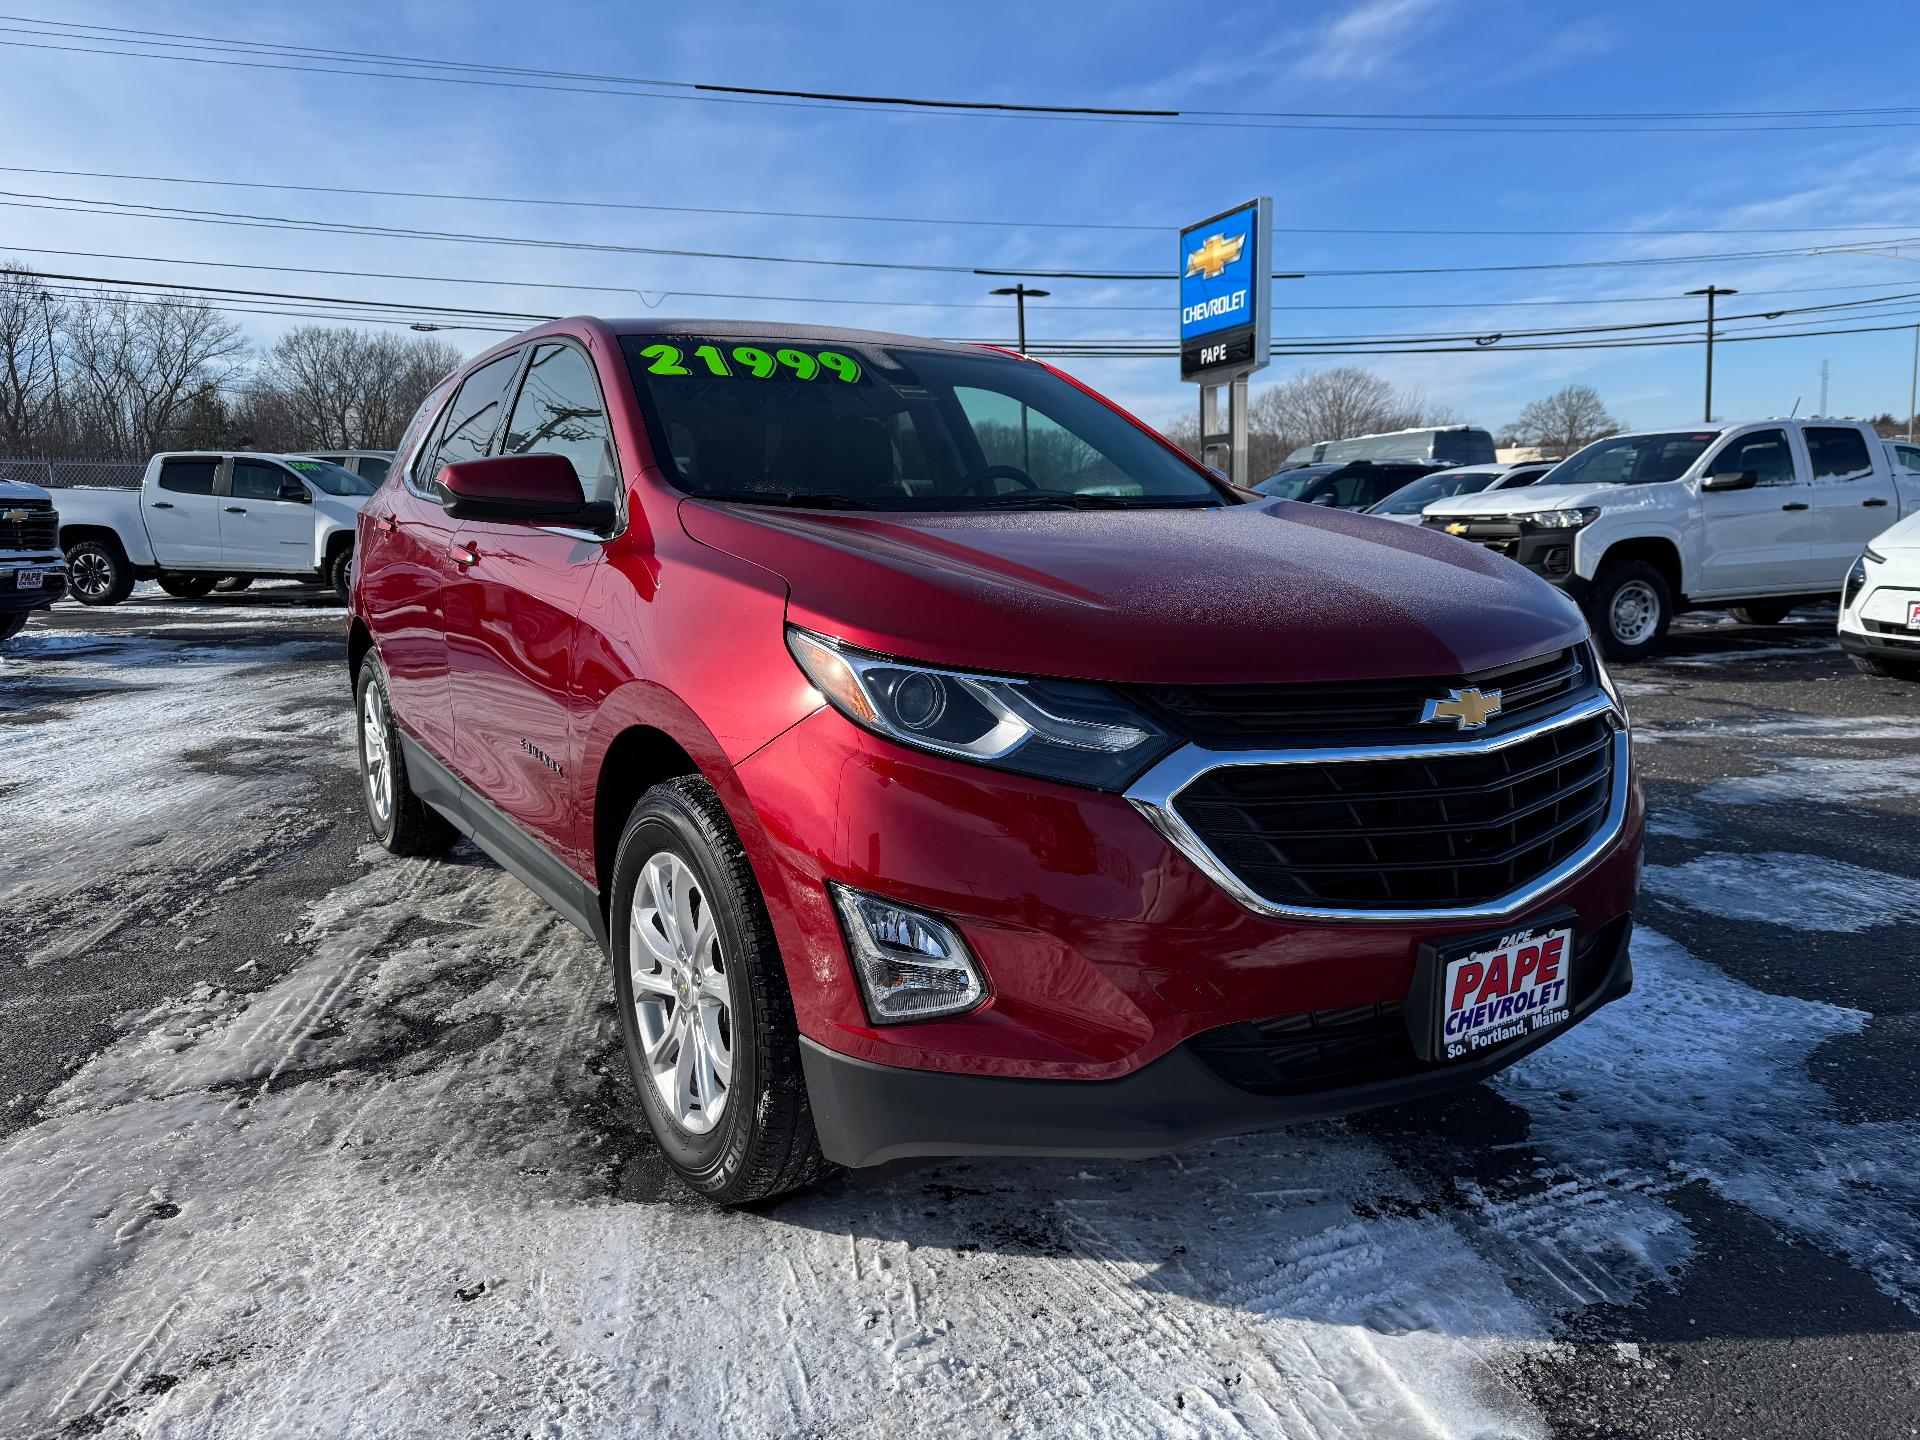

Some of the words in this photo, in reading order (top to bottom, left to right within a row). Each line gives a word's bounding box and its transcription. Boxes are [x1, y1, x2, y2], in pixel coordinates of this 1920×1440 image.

[1183, 290, 1246, 324] CHEVROLET
[640, 344, 861, 384] 21999
[1200, 344, 1227, 365] PAPE
[1497, 928, 1534, 949] PAPE
[1451, 936, 1565, 1011] PAPE
[1445, 978, 1565, 1036] CHEVROLET
[1447, 1043, 1467, 1059] So.
[1471, 1019, 1528, 1050] Portland,
[1532, 1009, 1570, 1030] Maine
